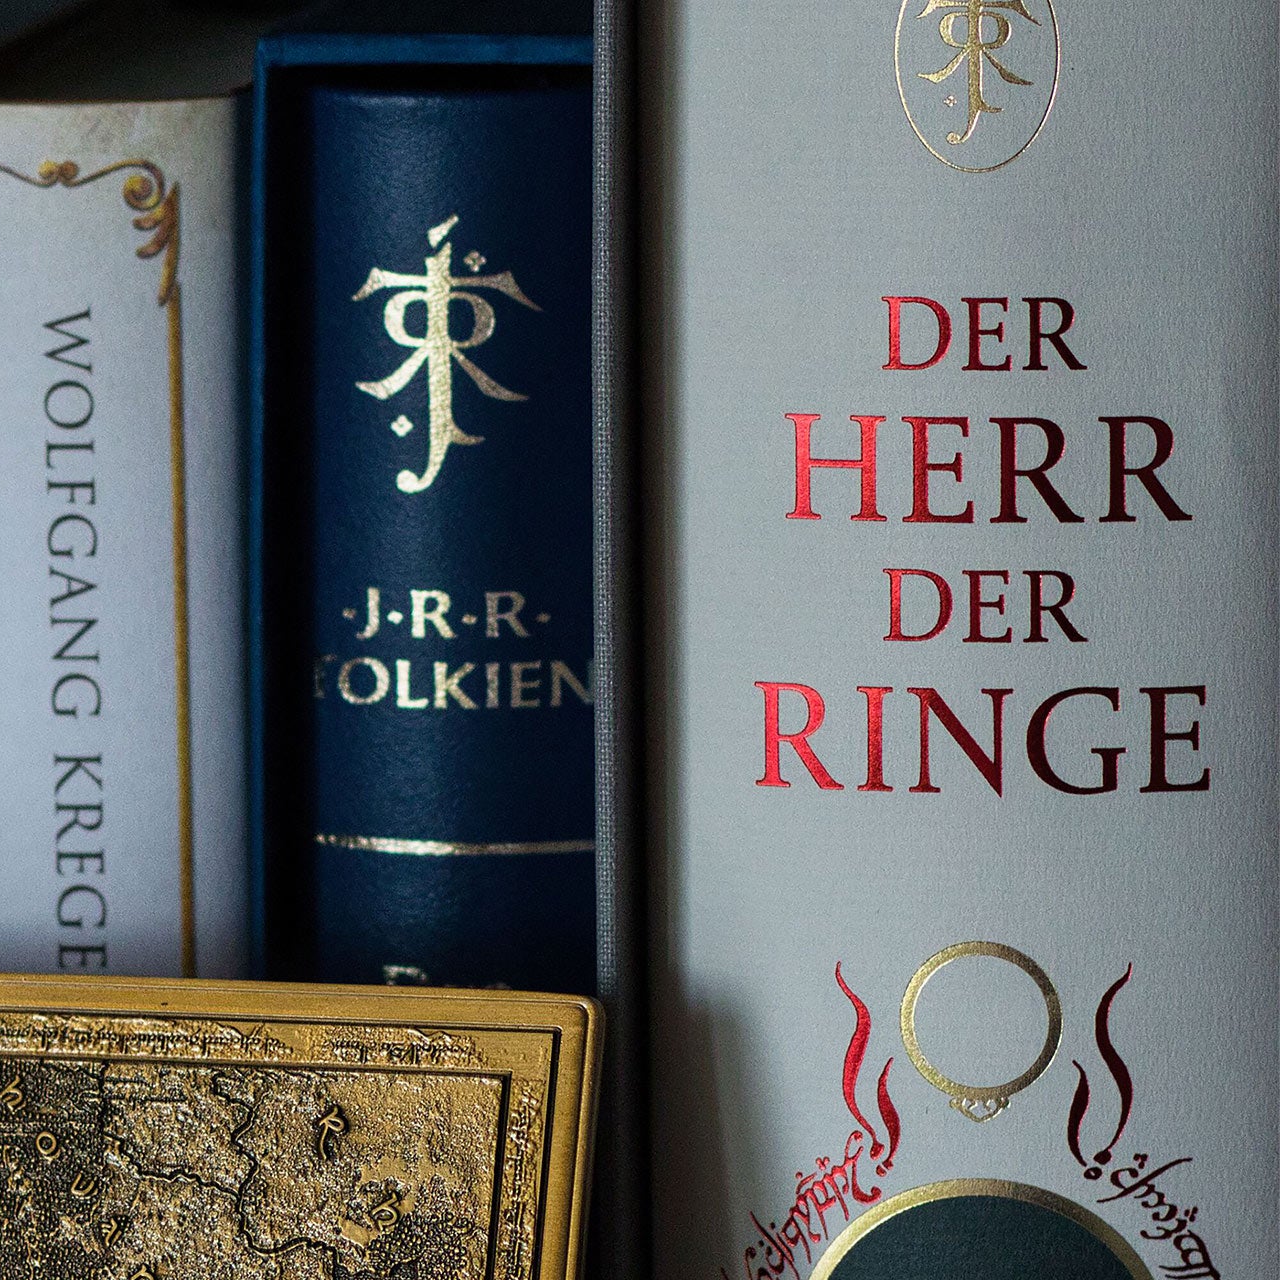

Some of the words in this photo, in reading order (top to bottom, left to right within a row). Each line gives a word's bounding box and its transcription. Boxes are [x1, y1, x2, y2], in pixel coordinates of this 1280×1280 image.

[885, 296, 1087, 371] DER
[43, 307, 102, 719] WOLFGANG
[784, 413, 1192, 524] HERR
[883, 569, 1087, 643] DER
[754, 680, 1210, 797] RINGE
[54, 754, 108, 969] KREGE
